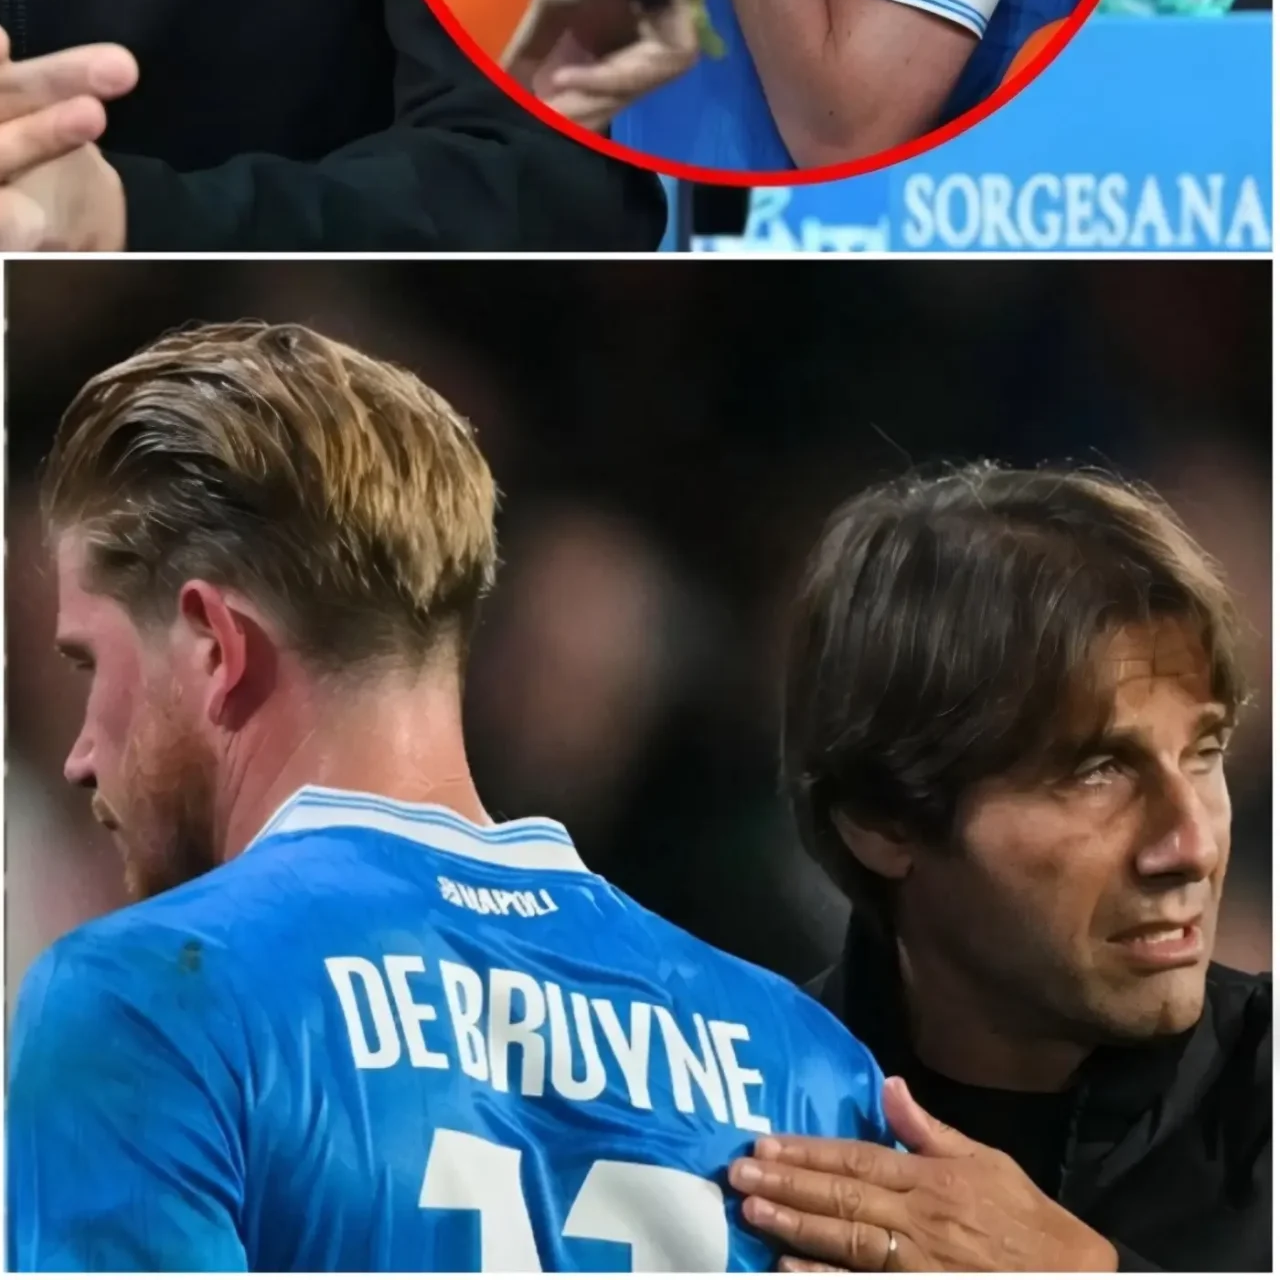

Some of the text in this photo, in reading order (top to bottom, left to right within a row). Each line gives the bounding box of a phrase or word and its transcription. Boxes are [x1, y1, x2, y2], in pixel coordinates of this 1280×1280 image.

[902, 172, 1273, 250] SORGESANA
[324, 955, 772, 1135] DE BRUYNE
